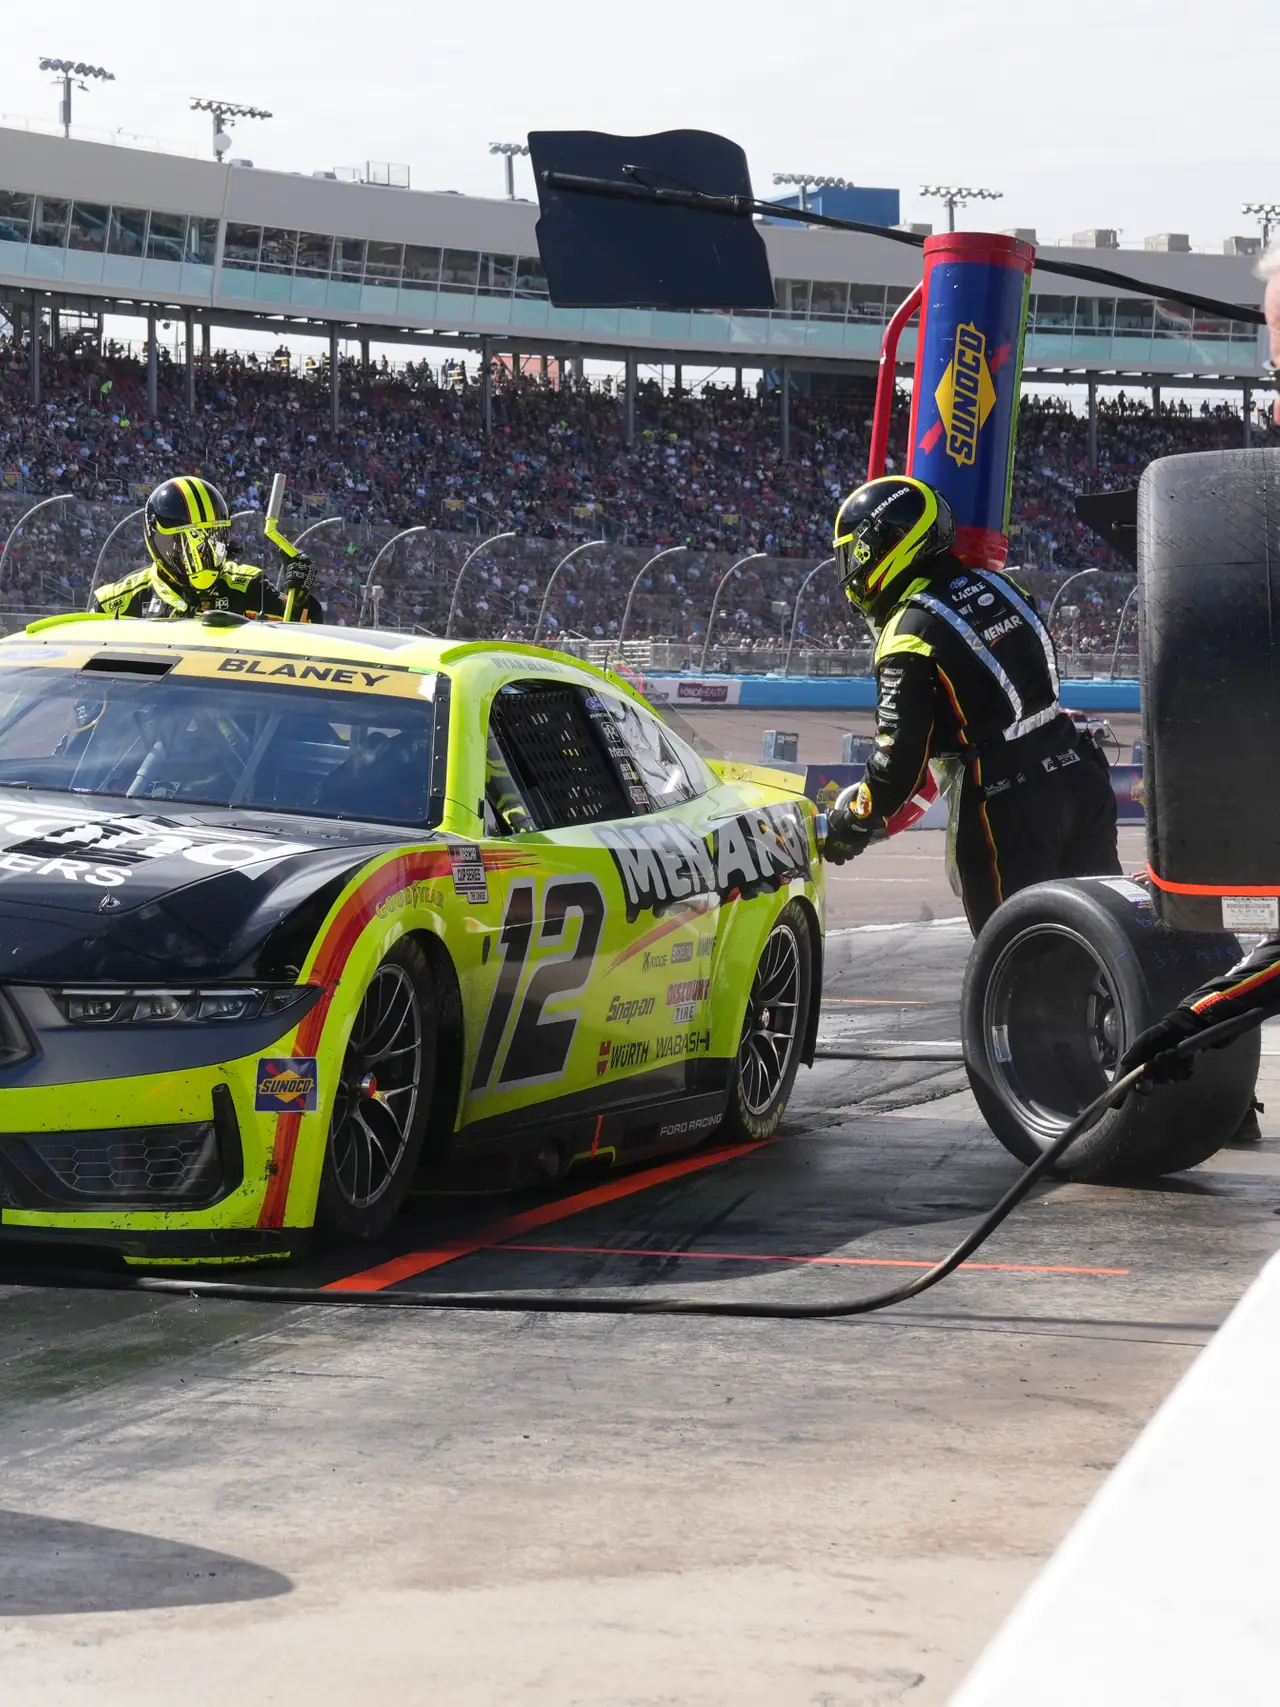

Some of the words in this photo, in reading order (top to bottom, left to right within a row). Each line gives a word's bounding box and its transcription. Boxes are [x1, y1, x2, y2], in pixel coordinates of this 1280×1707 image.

[949, 327, 984, 461] SUNOCO
[871, 487, 910, 518] MENARDS
[982, 615, 1023, 641] MENAR
[217, 657, 391, 688] BLANEY
[466, 868, 481, 881] SERIES
[375, 881, 444, 919] GOODYEAR
[469, 875, 607, 1096] 12
[666, 979, 710, 1005] DISCOUNT
[605, 995, 656, 1024] Snap-on
[675, 1003, 695, 1021] TIRE
[610, 1040, 650, 1070] WÜRTH
[656, 1028, 712, 1058] WABASH
[260, 1079, 312, 1093] SUNOCO
[660, 1121, 688, 1137] FORD
[688, 1113, 725, 1131] RACING
